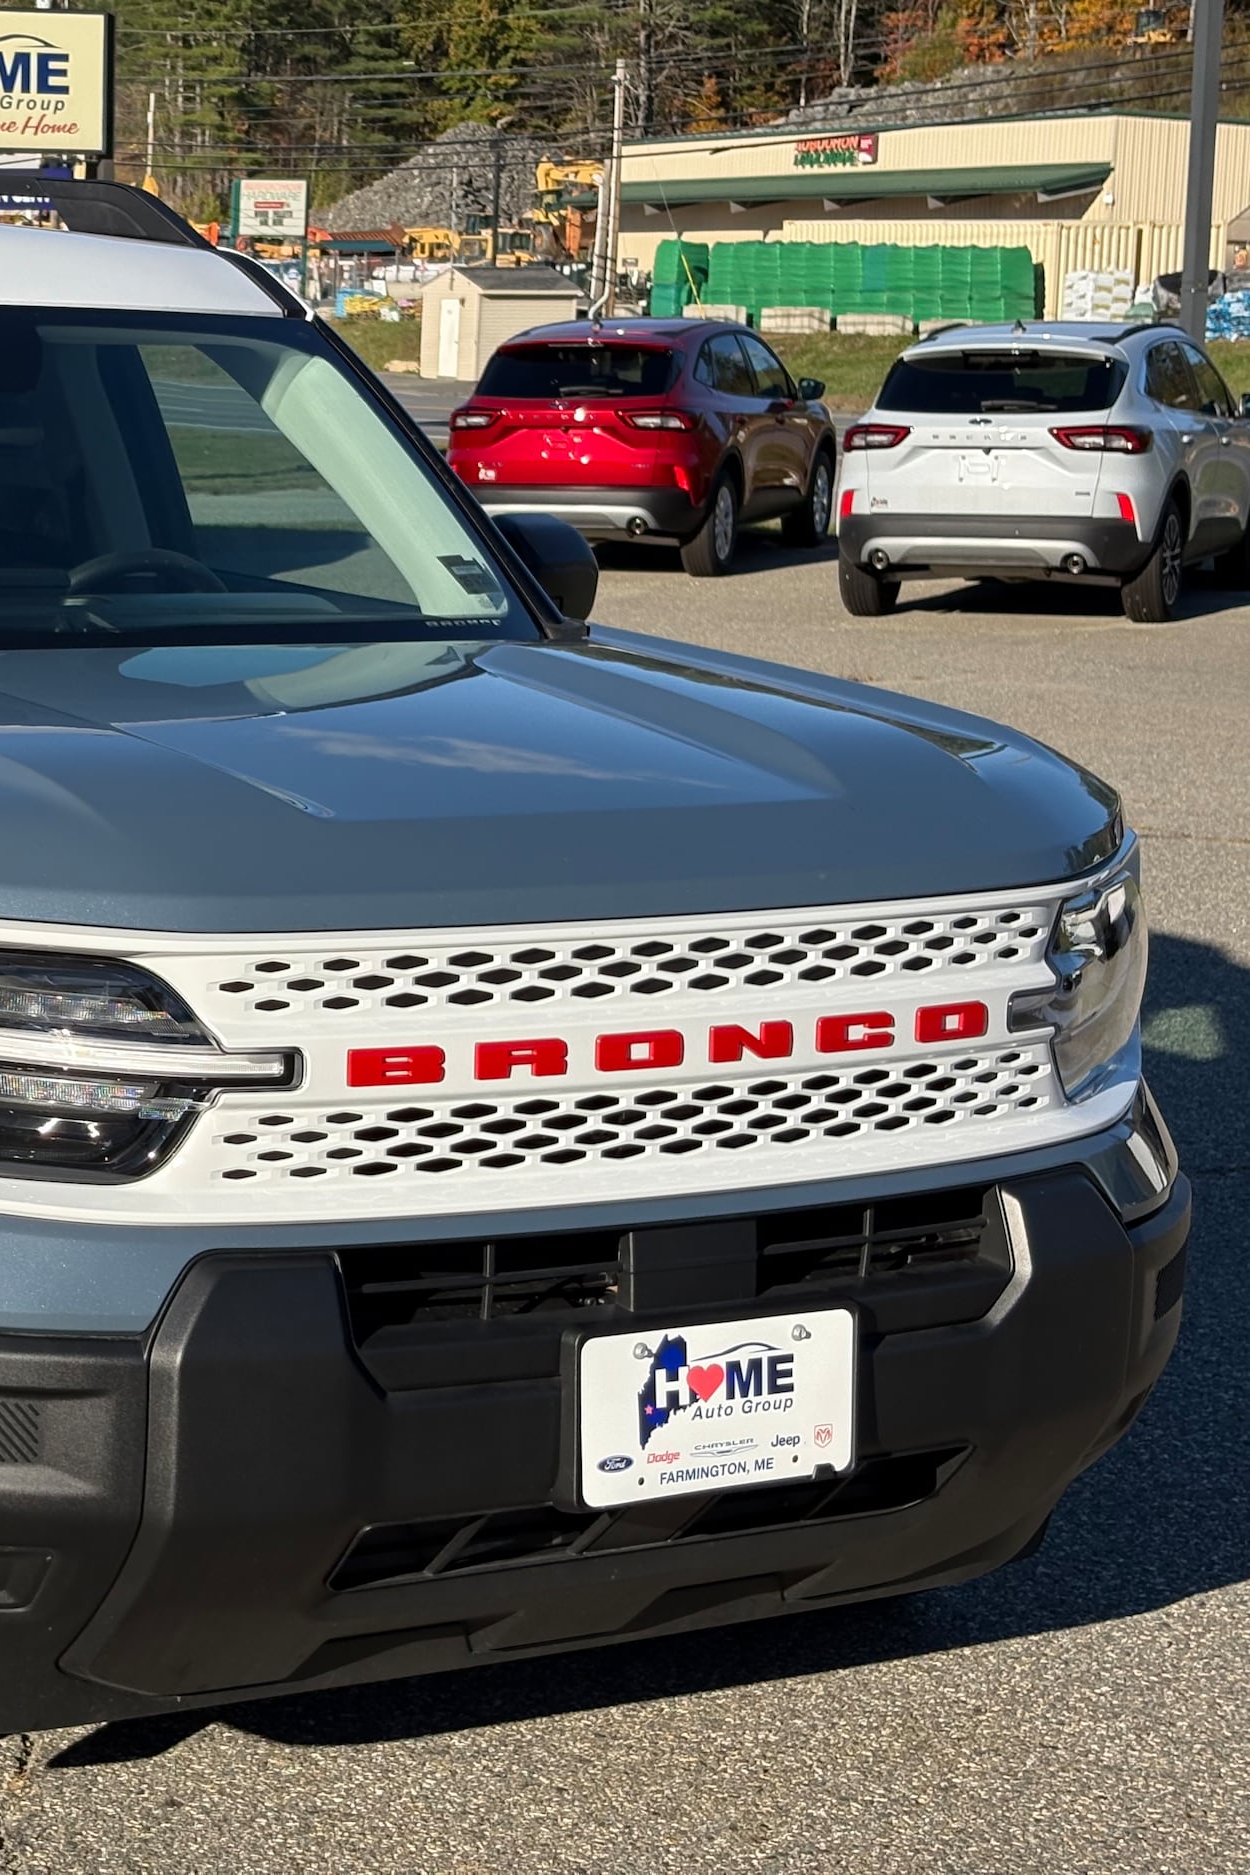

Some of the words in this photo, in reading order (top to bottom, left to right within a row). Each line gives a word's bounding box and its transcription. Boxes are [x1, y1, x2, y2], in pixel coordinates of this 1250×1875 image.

[21, 114, 79, 136] Home
[347, 1001, 988, 1087] BRONCO
[691, 1403, 734, 1421] Auto
[741, 1397, 794, 1415] Group
[694, 1438, 755, 1450] CHRYSLER
[770, 1434, 801, 1448] Jeep
[602, 1456, 629, 1471] Ford
[646, 1450, 681, 1464] Dodge
[660, 1461, 750, 1485] FARMINGTON,
[753, 1457, 775, 1472] ME
